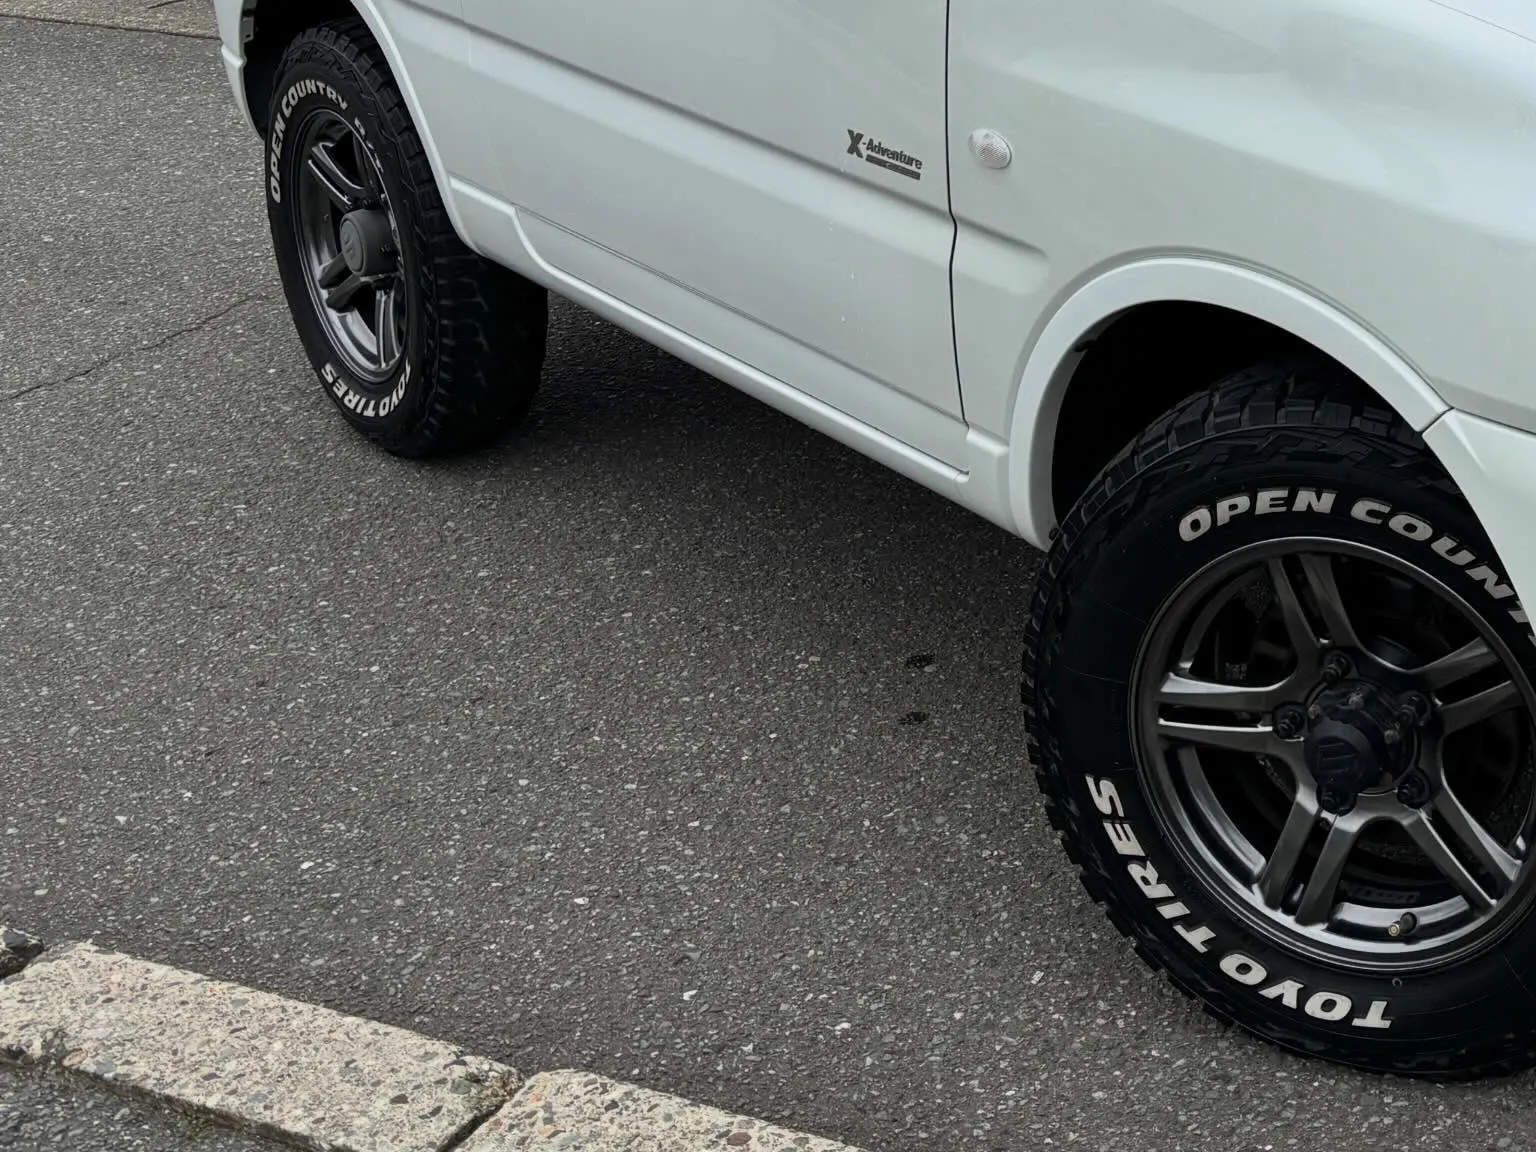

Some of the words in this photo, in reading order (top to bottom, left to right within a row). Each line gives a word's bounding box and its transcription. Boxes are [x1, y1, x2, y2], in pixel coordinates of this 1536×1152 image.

[270, 112, 287, 204] OPEN
[281, 79, 348, 118] COUNTRY
[846, 128, 922, 169] X-Adventure
[321, 363, 376, 417] TIRES
[378, 356, 411, 417] TOYO
[1178, 486, 1338, 542] OPEN
[1085, 774, 1217, 954] TIRES
[1219, 952, 1393, 1029] TOYO
